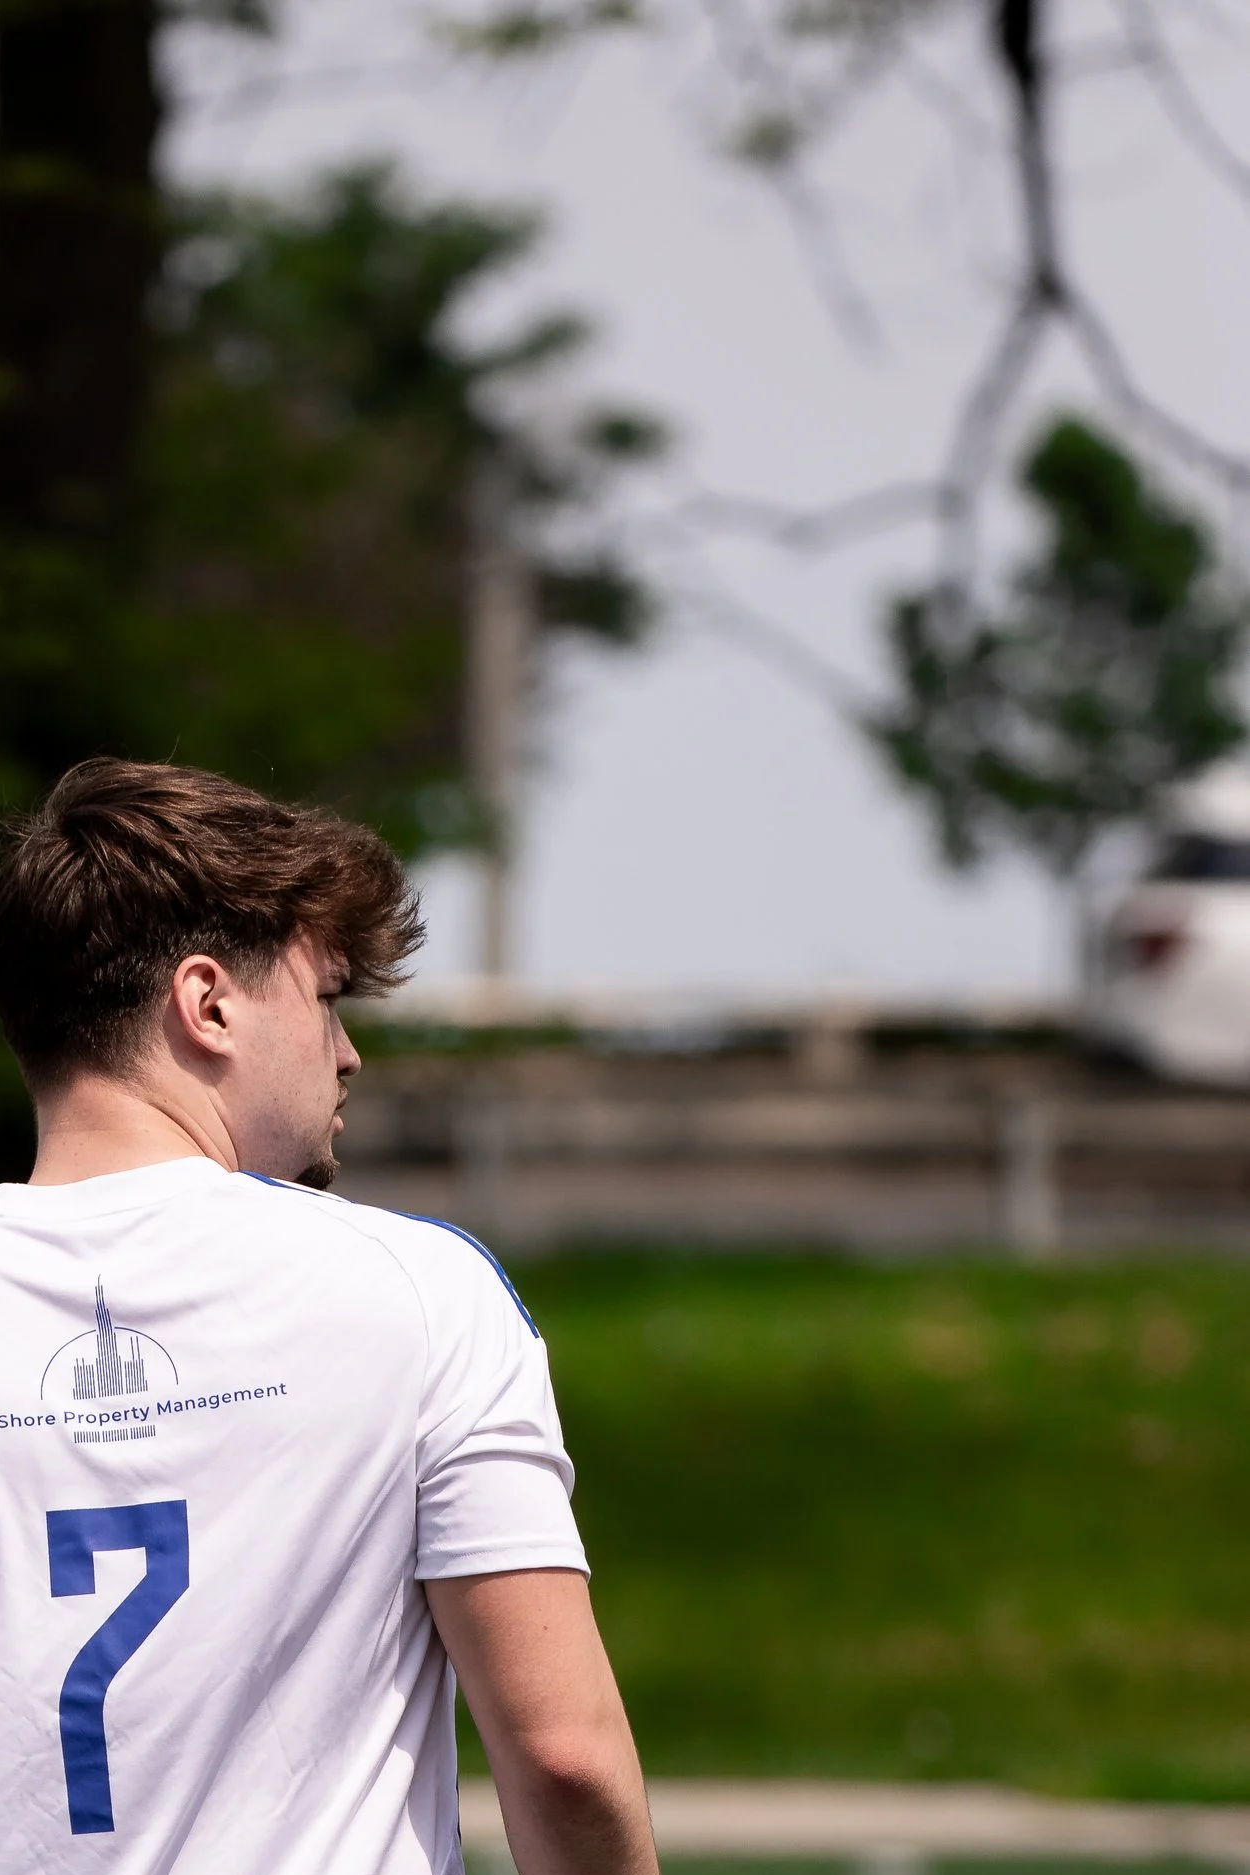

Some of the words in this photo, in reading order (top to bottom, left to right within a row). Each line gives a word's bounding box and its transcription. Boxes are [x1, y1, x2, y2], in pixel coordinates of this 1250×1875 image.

[63, 1404, 150, 1427] Property
[156, 1382, 288, 1416] Management
[46, 1499, 190, 1836] 7
